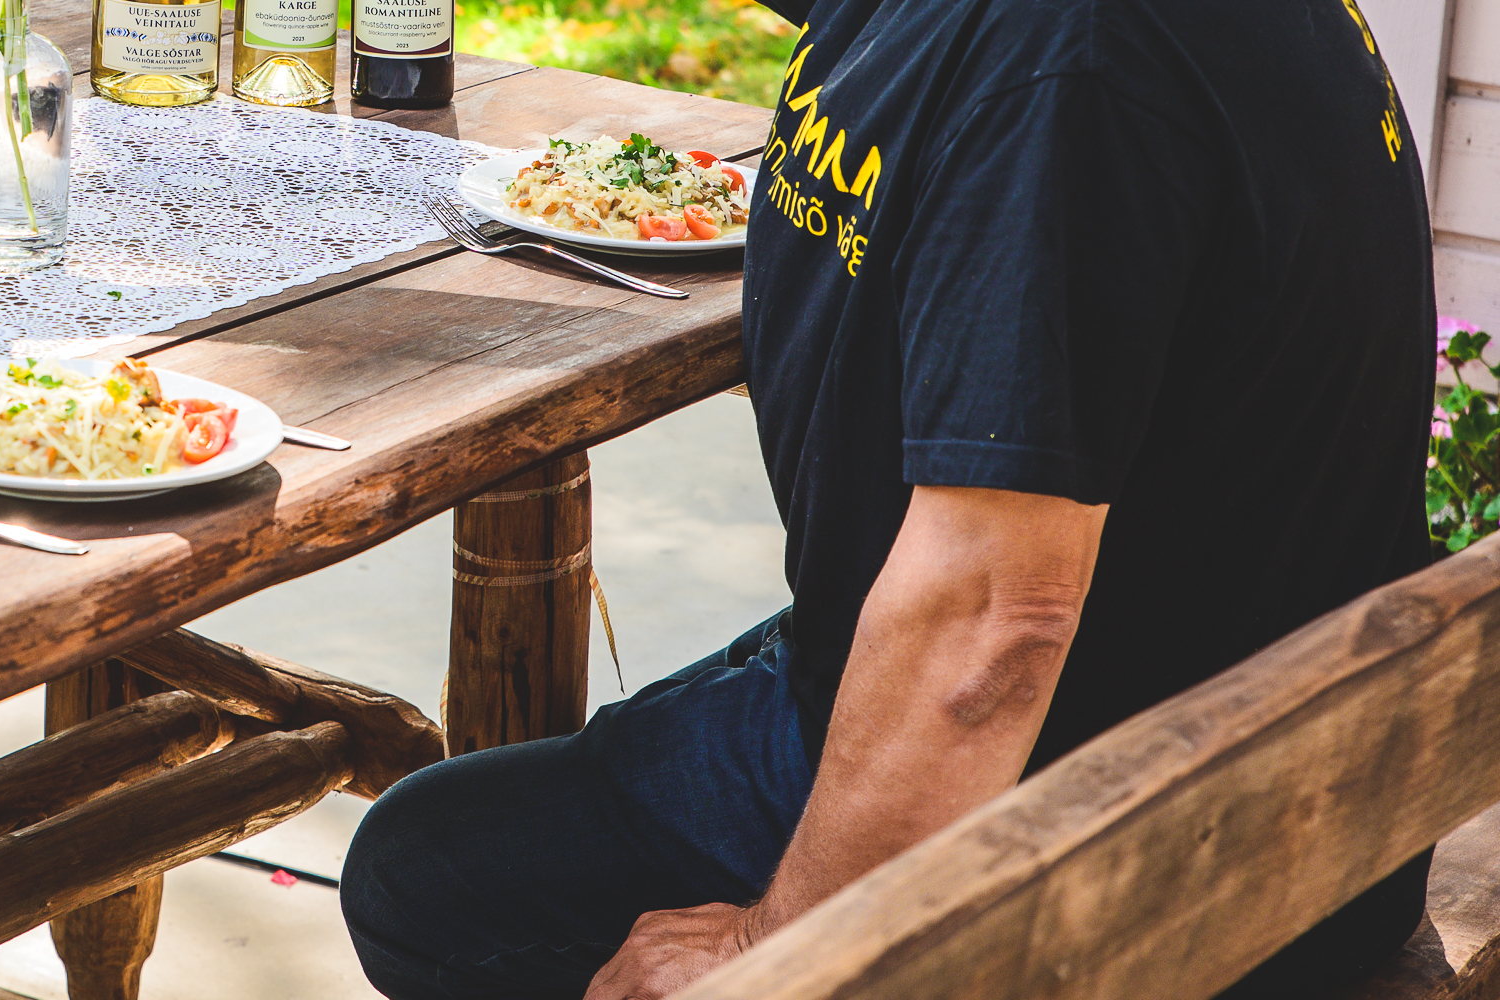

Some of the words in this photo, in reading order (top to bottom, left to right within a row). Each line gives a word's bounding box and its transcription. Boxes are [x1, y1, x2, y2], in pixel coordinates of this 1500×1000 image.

[279, 0, 316, 10] KARGE
[129, 7, 201, 18] UUE-SAALUSE
[255, 12, 334, 22] ebaküdoonia-õunavein
[365, 6, 442, 18] ROMANTILINE
[135, 18, 196, 28] VEINITALU
[262, 22, 286, 30] flowering
[360, 20, 432, 30] mustsõstra-vaarika
[126, 46, 160, 57] VALGE
[162, 48, 202, 57] SÕSTAR
